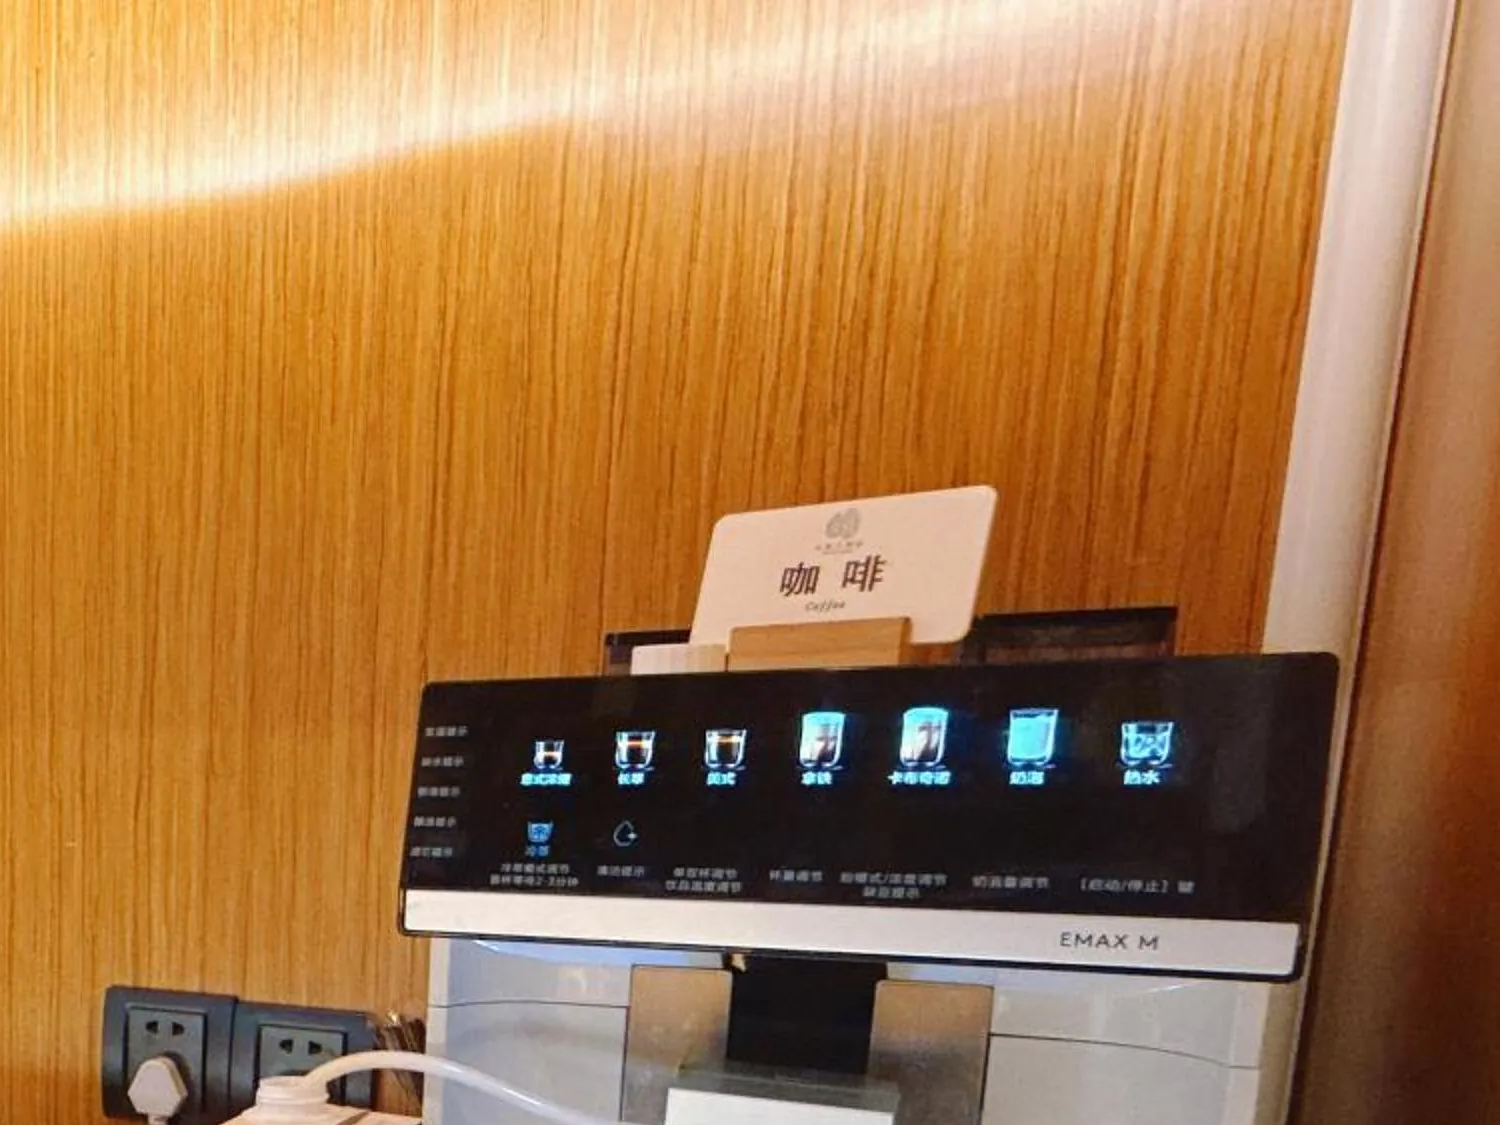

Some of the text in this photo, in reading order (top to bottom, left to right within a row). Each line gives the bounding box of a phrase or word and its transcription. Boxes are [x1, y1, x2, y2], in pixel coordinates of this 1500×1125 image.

[779, 554, 886, 596] 咖啡
[887, 771, 951, 786] 卡布奇诺
[1060, 931, 1160, 950] EMAX M
